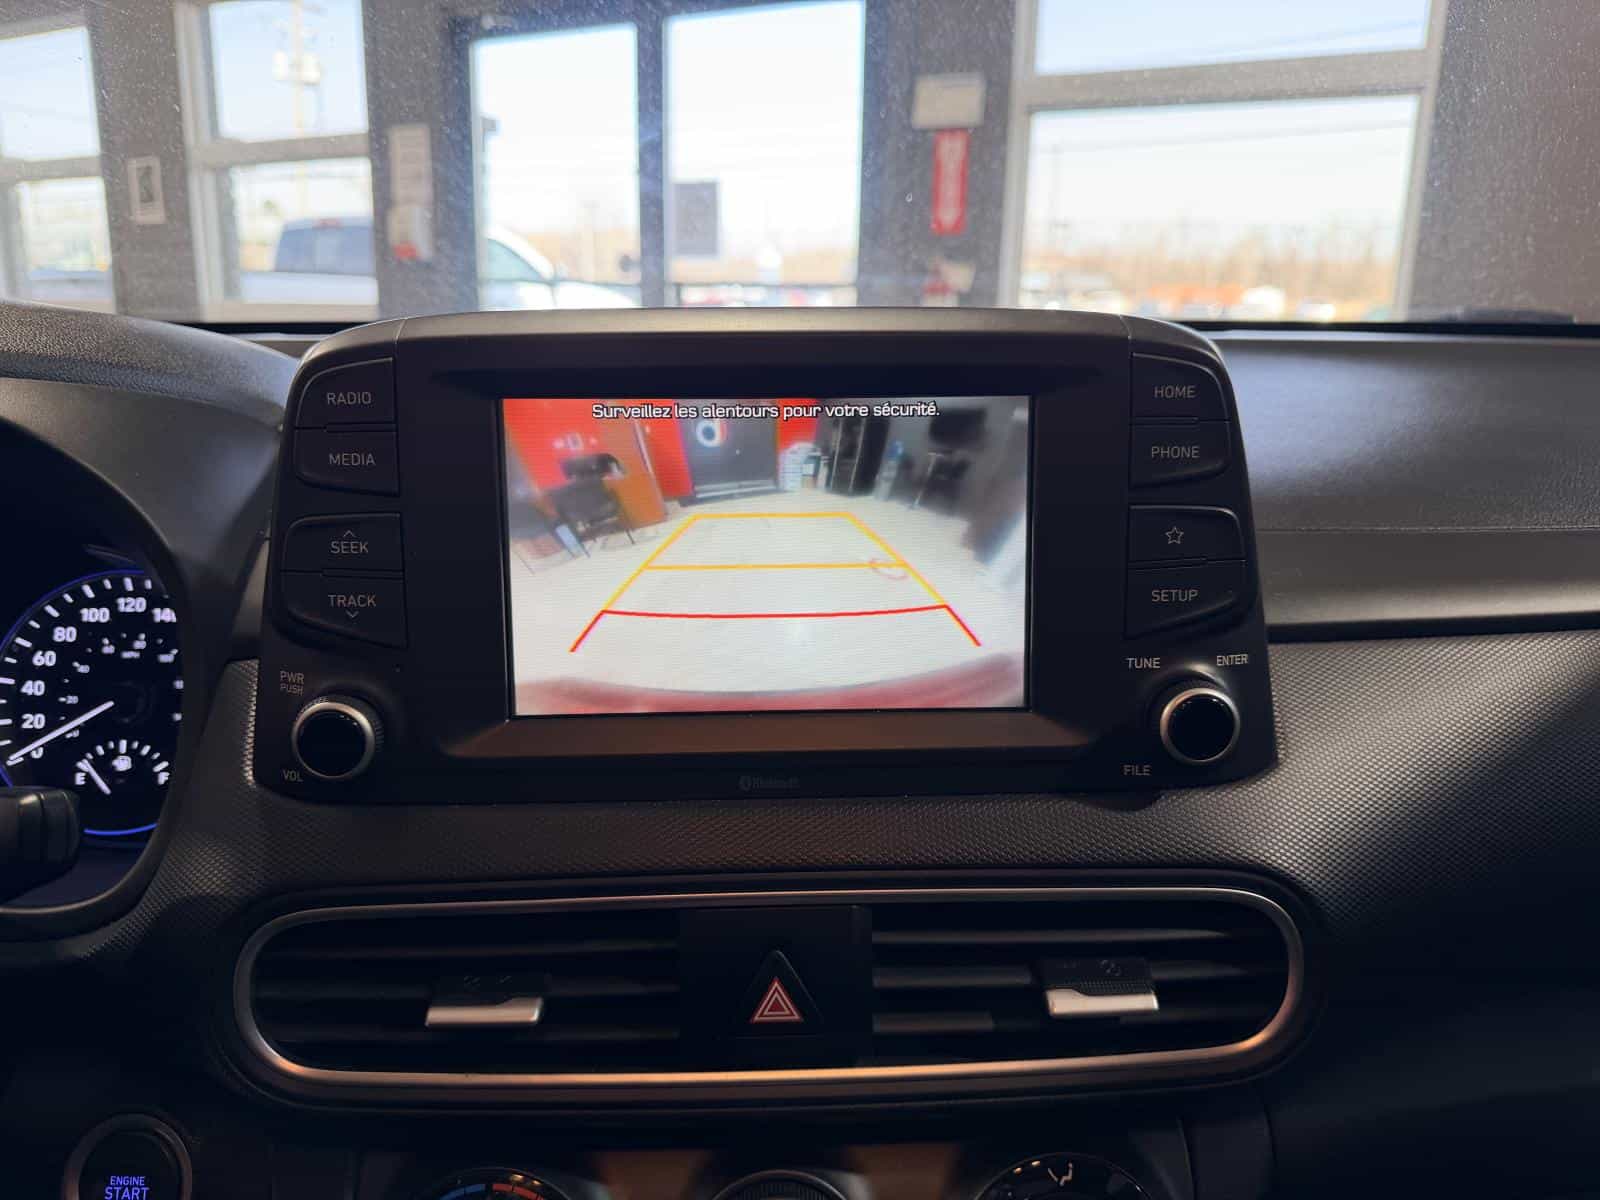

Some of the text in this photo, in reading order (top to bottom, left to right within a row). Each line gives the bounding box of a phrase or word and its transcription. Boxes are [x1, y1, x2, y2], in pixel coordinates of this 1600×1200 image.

[326, 391, 371, 406] RADIO
[1154, 385, 1196, 399] HOME
[592, 402, 940, 420] Surveillez les alentours pour votre sécurité.
[1151, 446, 1199, 459] PHONE
[328, 453, 376, 467] MEDIA
[330, 540, 369, 554] SEEK
[328, 594, 376, 608] TRACK
[1151, 589, 1198, 603] SETUP
[117, 597, 147, 612] 120
[80, 608, 110, 623] 100
[53, 626, 77, 642] 80
[32, 650, 57, 667] 60
[1127, 657, 1161, 669] TUNE
[1216, 654, 1249, 666] ENTER
[280, 670, 305, 685] PWR
[21, 680, 45, 696] 40
[280, 682, 304, 696] PUSH
[21, 713, 45, 729] 20
[283, 769, 304, 783] VOL
[1123, 764, 1151, 776] FILE
[75, 772, 86, 785] E
[158, 772, 170, 785] F
[110, 1175, 146, 1186] ENGINE
[104, 1186, 150, 1200] START
